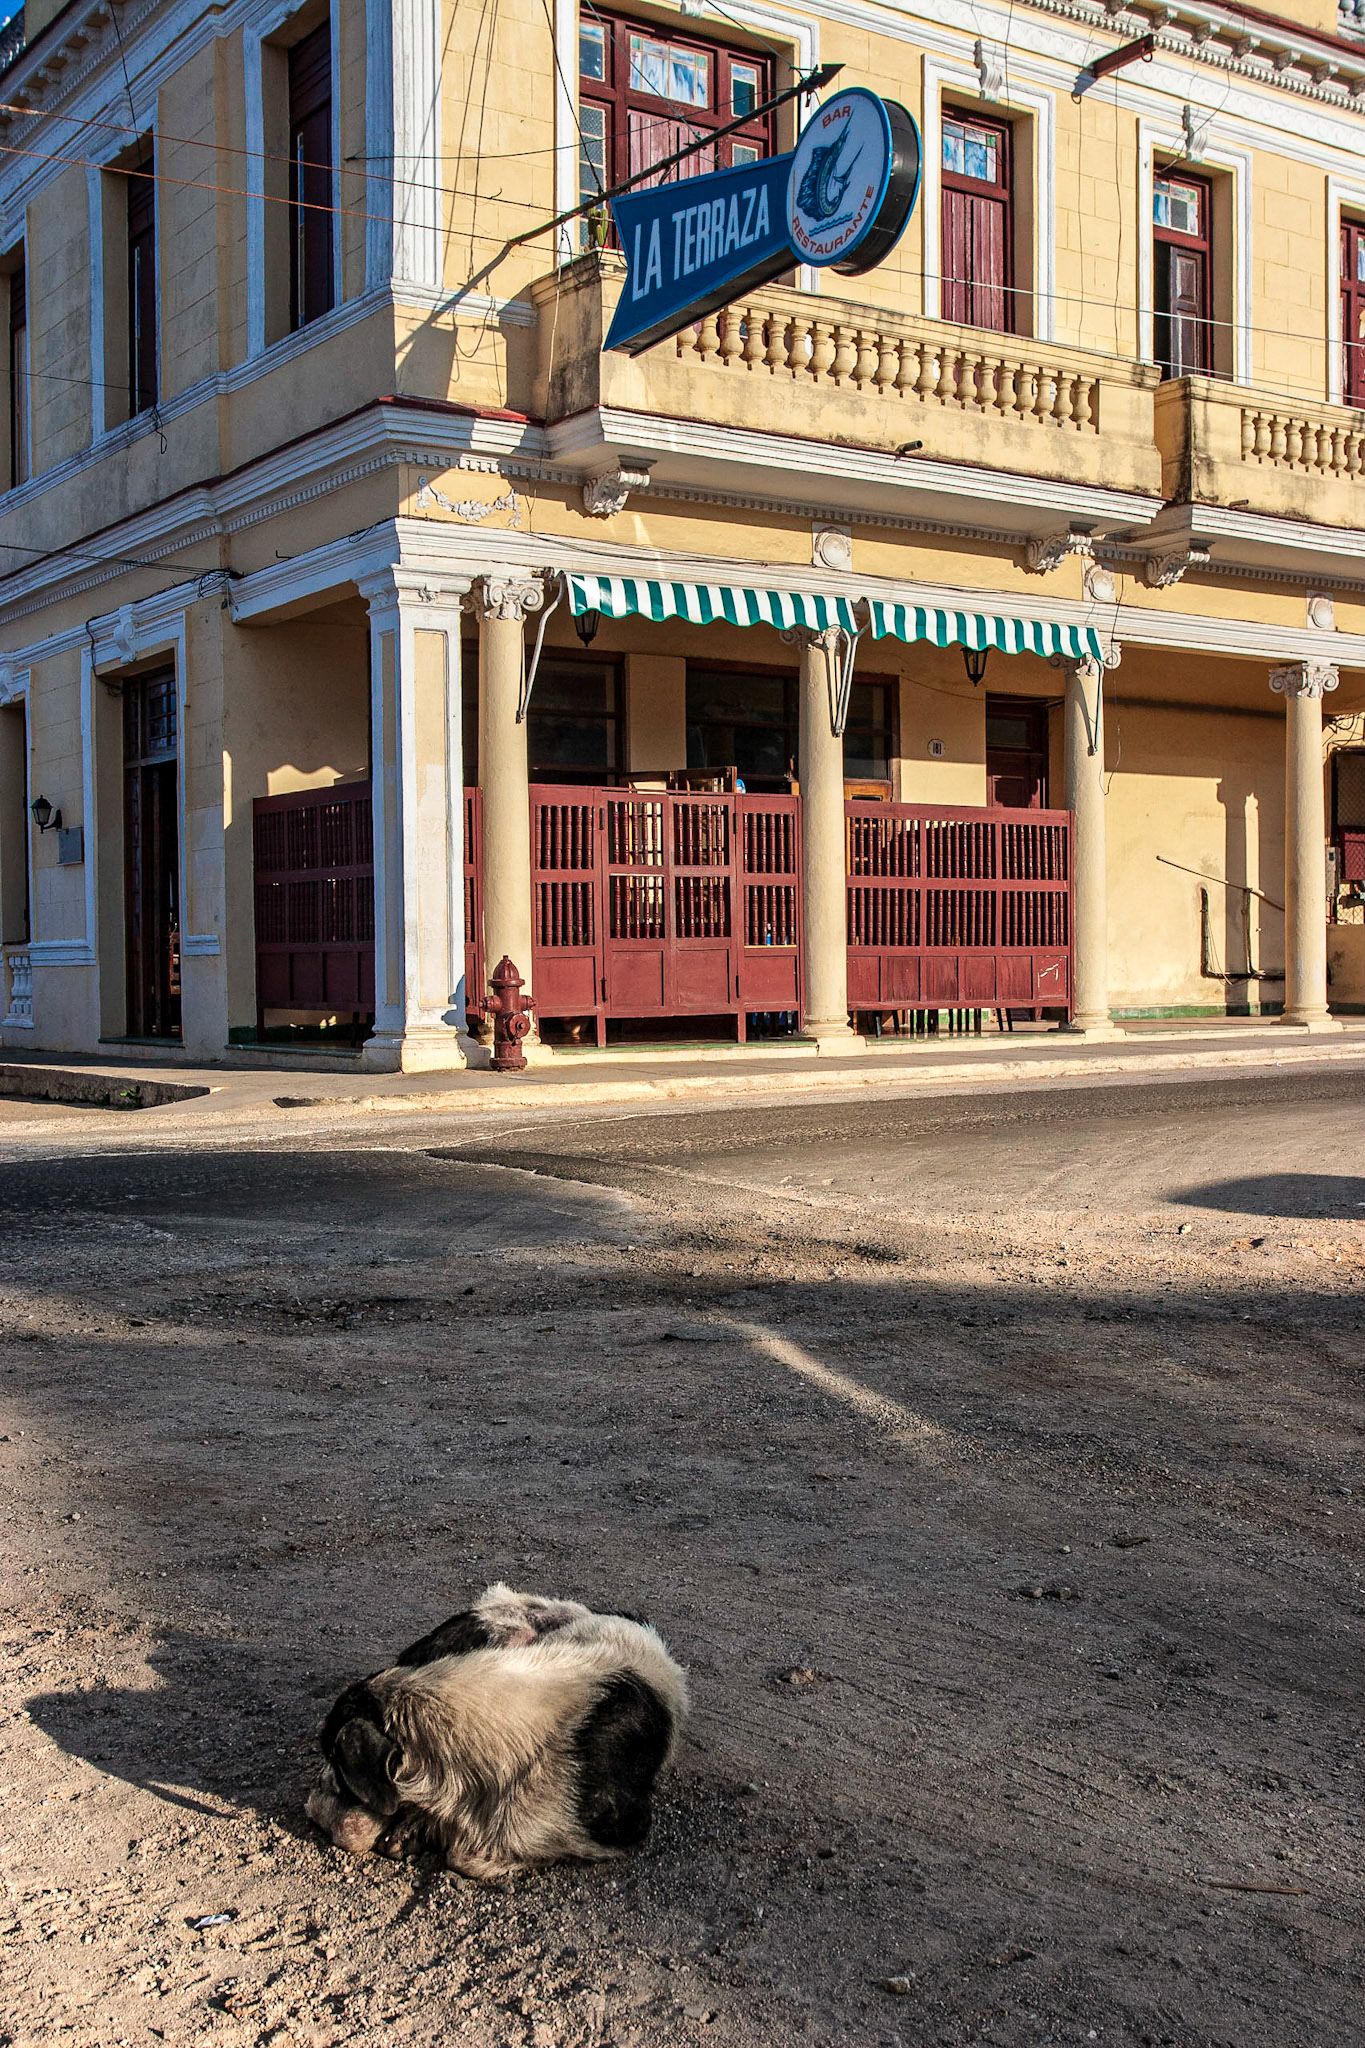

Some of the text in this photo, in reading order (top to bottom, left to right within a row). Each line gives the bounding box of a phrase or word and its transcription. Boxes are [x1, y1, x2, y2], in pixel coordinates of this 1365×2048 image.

[822, 106, 851, 128] BAR
[632, 184, 770, 302] LA TERRAZA
[792, 185, 875, 255] RESTAURANTE
